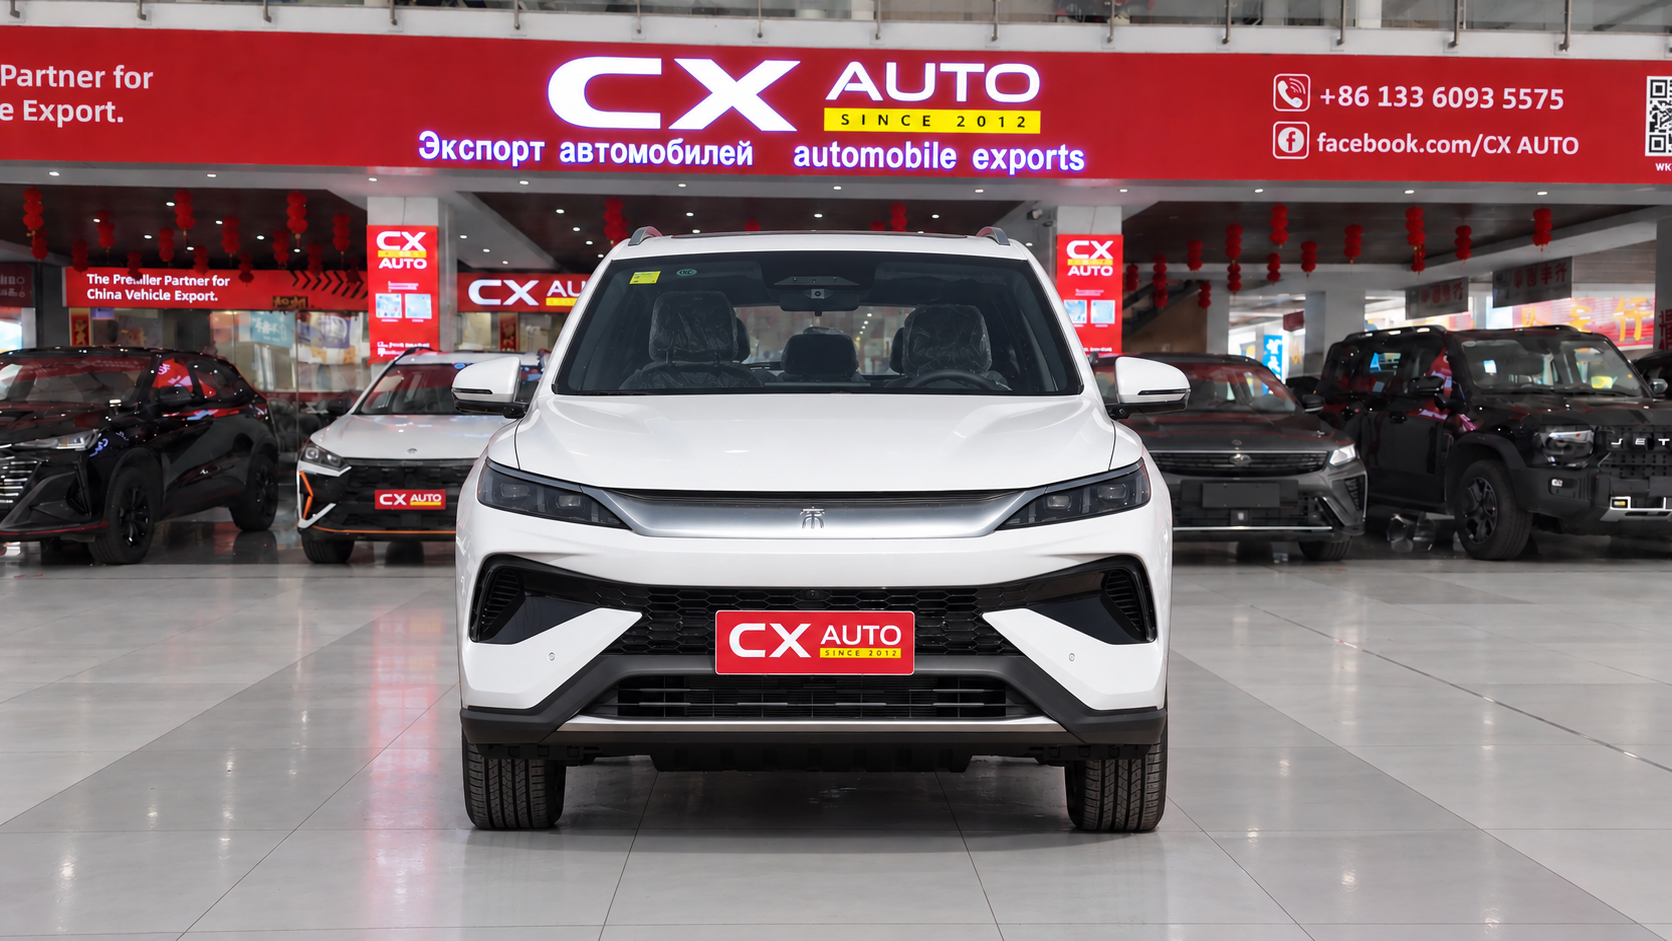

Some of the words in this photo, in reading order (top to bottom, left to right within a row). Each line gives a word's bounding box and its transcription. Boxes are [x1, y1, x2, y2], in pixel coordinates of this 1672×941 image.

[1, 64, 105, 88] Partner
[113, 65, 154, 89] for
[547, 57, 800, 132] CX
[825, 61, 1041, 103] AUTO
[1320, 85, 1369, 107] +86
[1378, 86, 1423, 108] 133
[1432, 87, 1494, 109] 6093
[1502, 88, 1564, 110] 5575
[23, 99, 124, 128] Export.
[841, 113, 931, 127] SINCE
[956, 115, 1026, 128] 2012
[418, 131, 545, 167] Экспорт
[559, 138, 753, 165] автомобилей
[1316, 132, 1511, 158] facebook.com/CX
[1516, 136, 1579, 155] AUTO
[794, 141, 957, 169] automobile
[972, 144, 1085, 175] exports
[376, 231, 427, 252] CX
[1066, 240, 1113, 259] CX
[378, 257, 428, 270] AUTO
[1067, 265, 1114, 277] AUTO
[86, 273, 110, 285] The
[164, 275, 210, 287] Partner
[212, 275, 231, 287] for
[468, 279, 539, 306] CX
[86, 288, 122, 300] China
[125, 289, 171, 301] Vehicle
[174, 290, 219, 303] Export.
[379, 494, 407, 506] CX
[410, 494, 442, 502] AUTO
[729, 623, 812, 658] CX
[820, 625, 902, 646] AUTO
